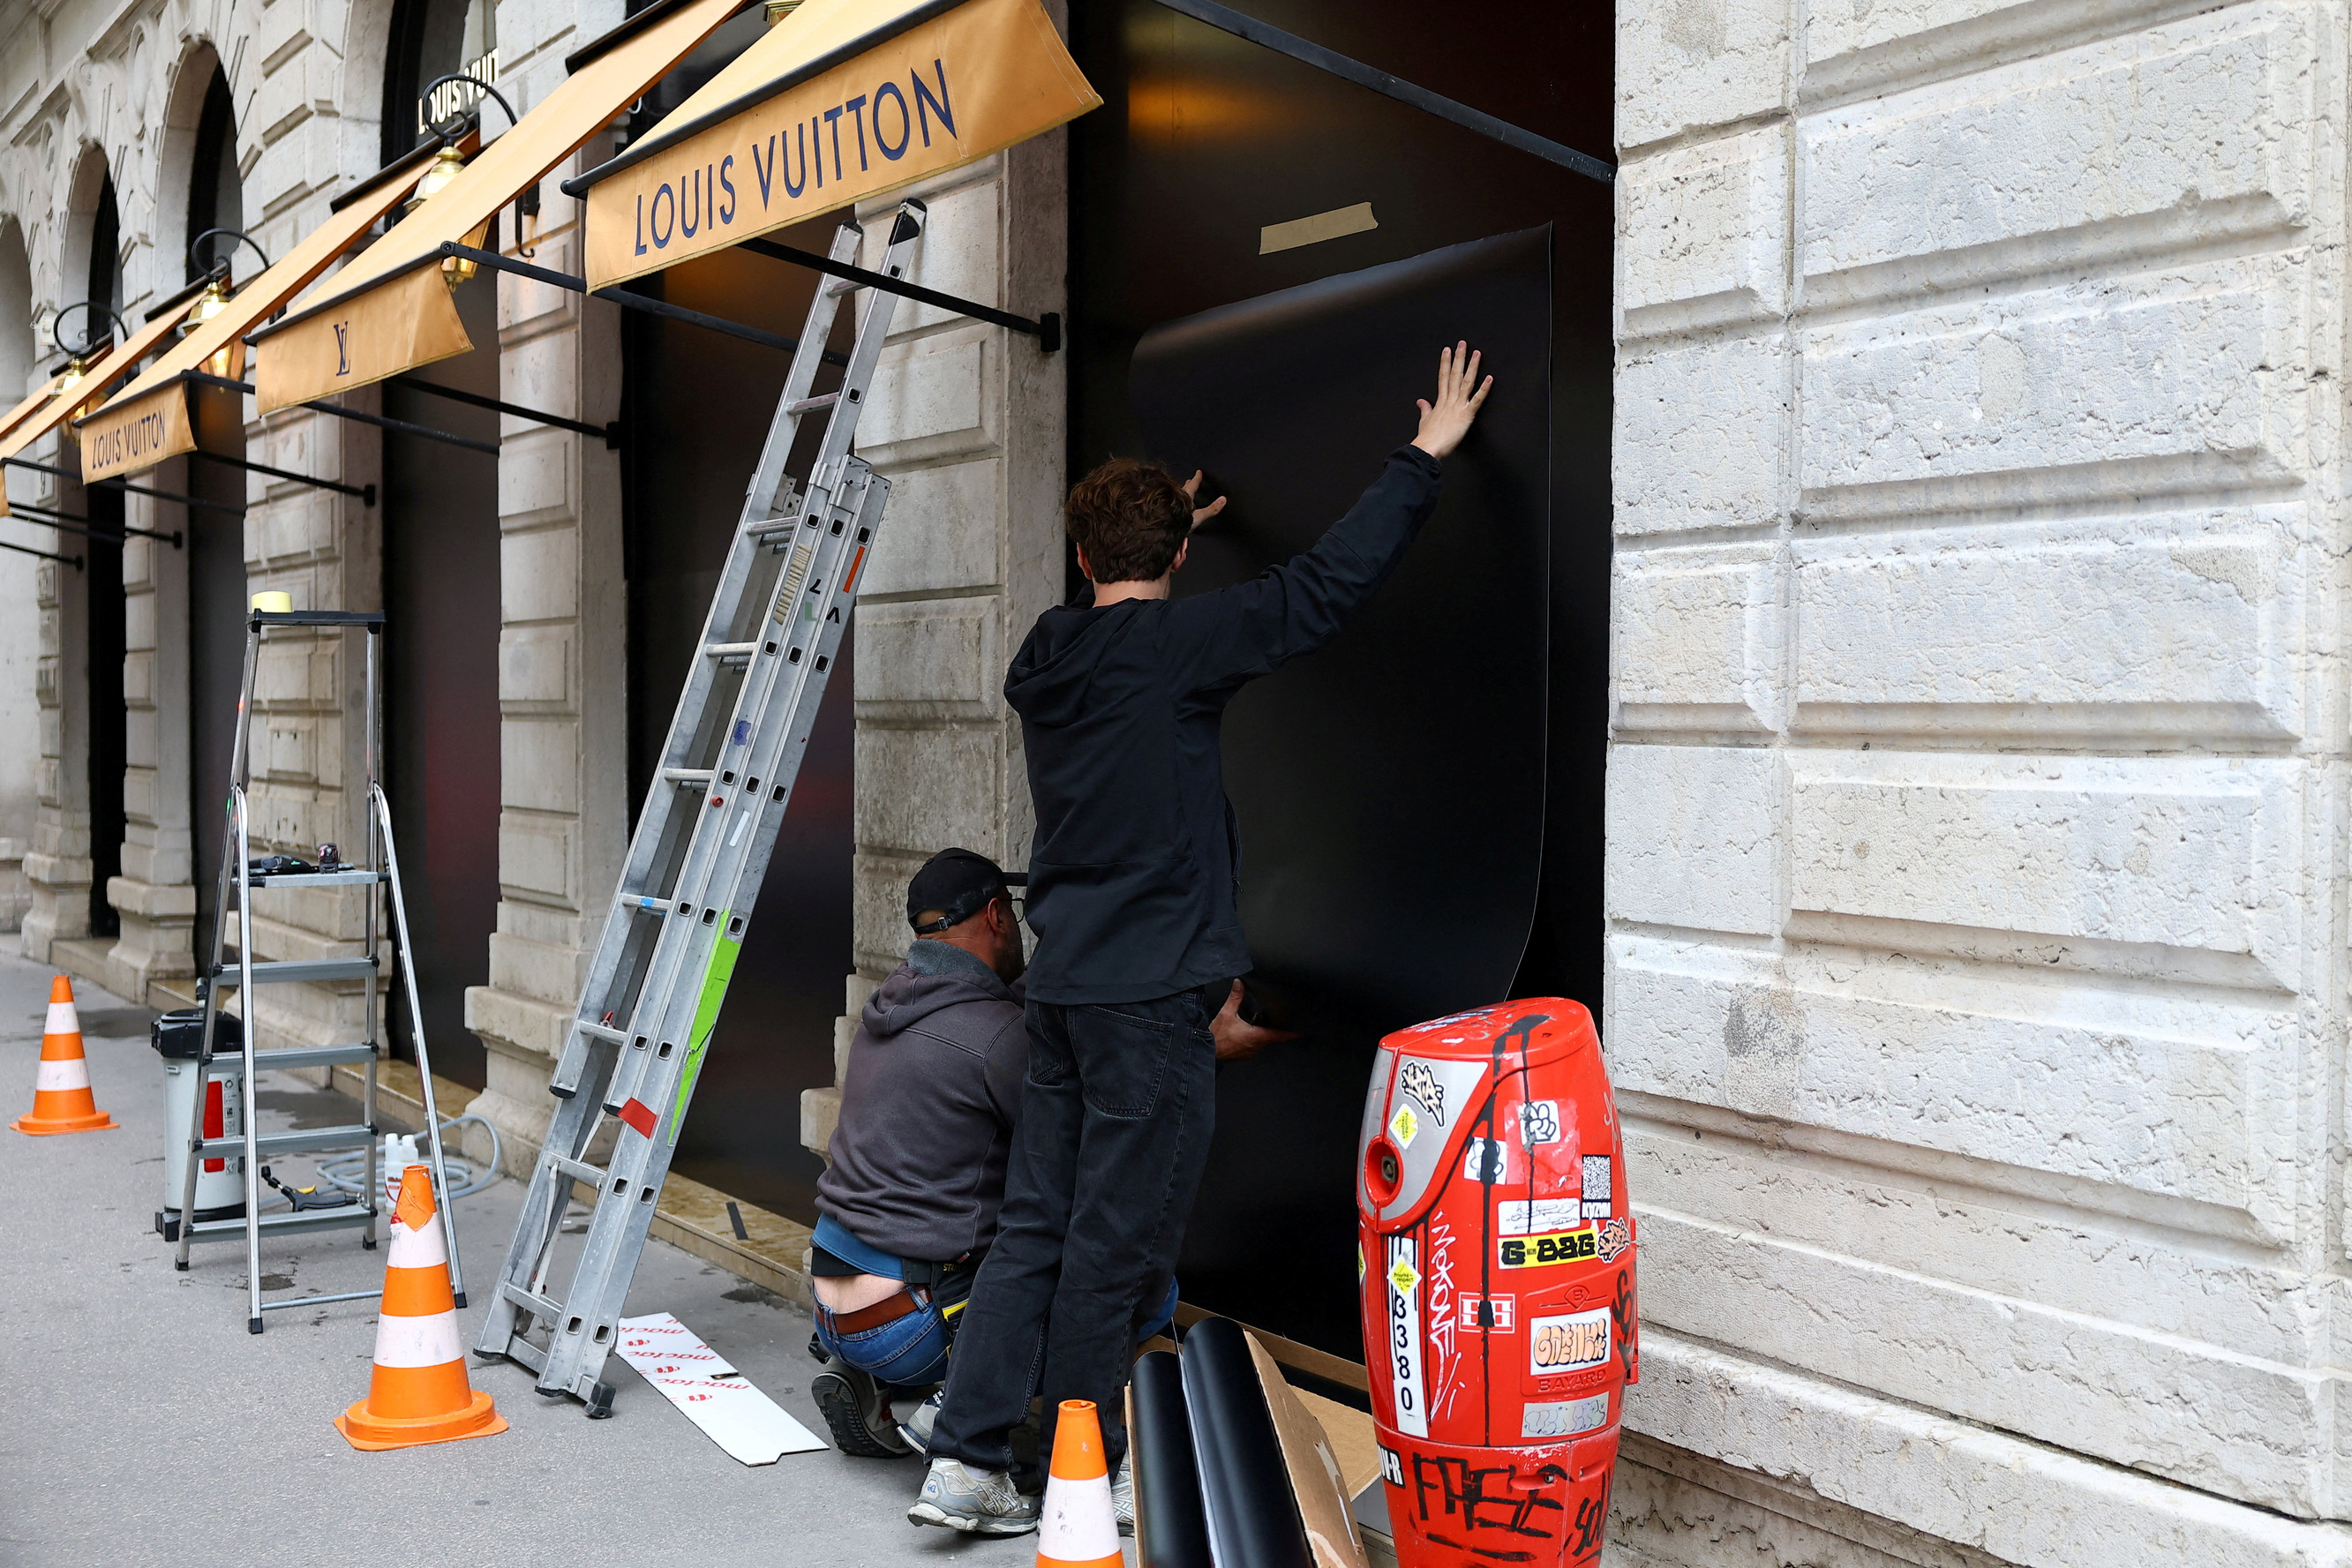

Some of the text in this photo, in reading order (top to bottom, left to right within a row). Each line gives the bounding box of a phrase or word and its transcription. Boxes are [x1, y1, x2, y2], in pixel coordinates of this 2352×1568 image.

[635, 57, 958, 257] LOUIS VUITTON
[92, 408, 166, 469] LOUIS VUITTON
[627, 1351, 716, 1361] mactac
[656, 1377, 750, 1390] mactac
[1538, 1369, 1606, 1392] BAYARD
